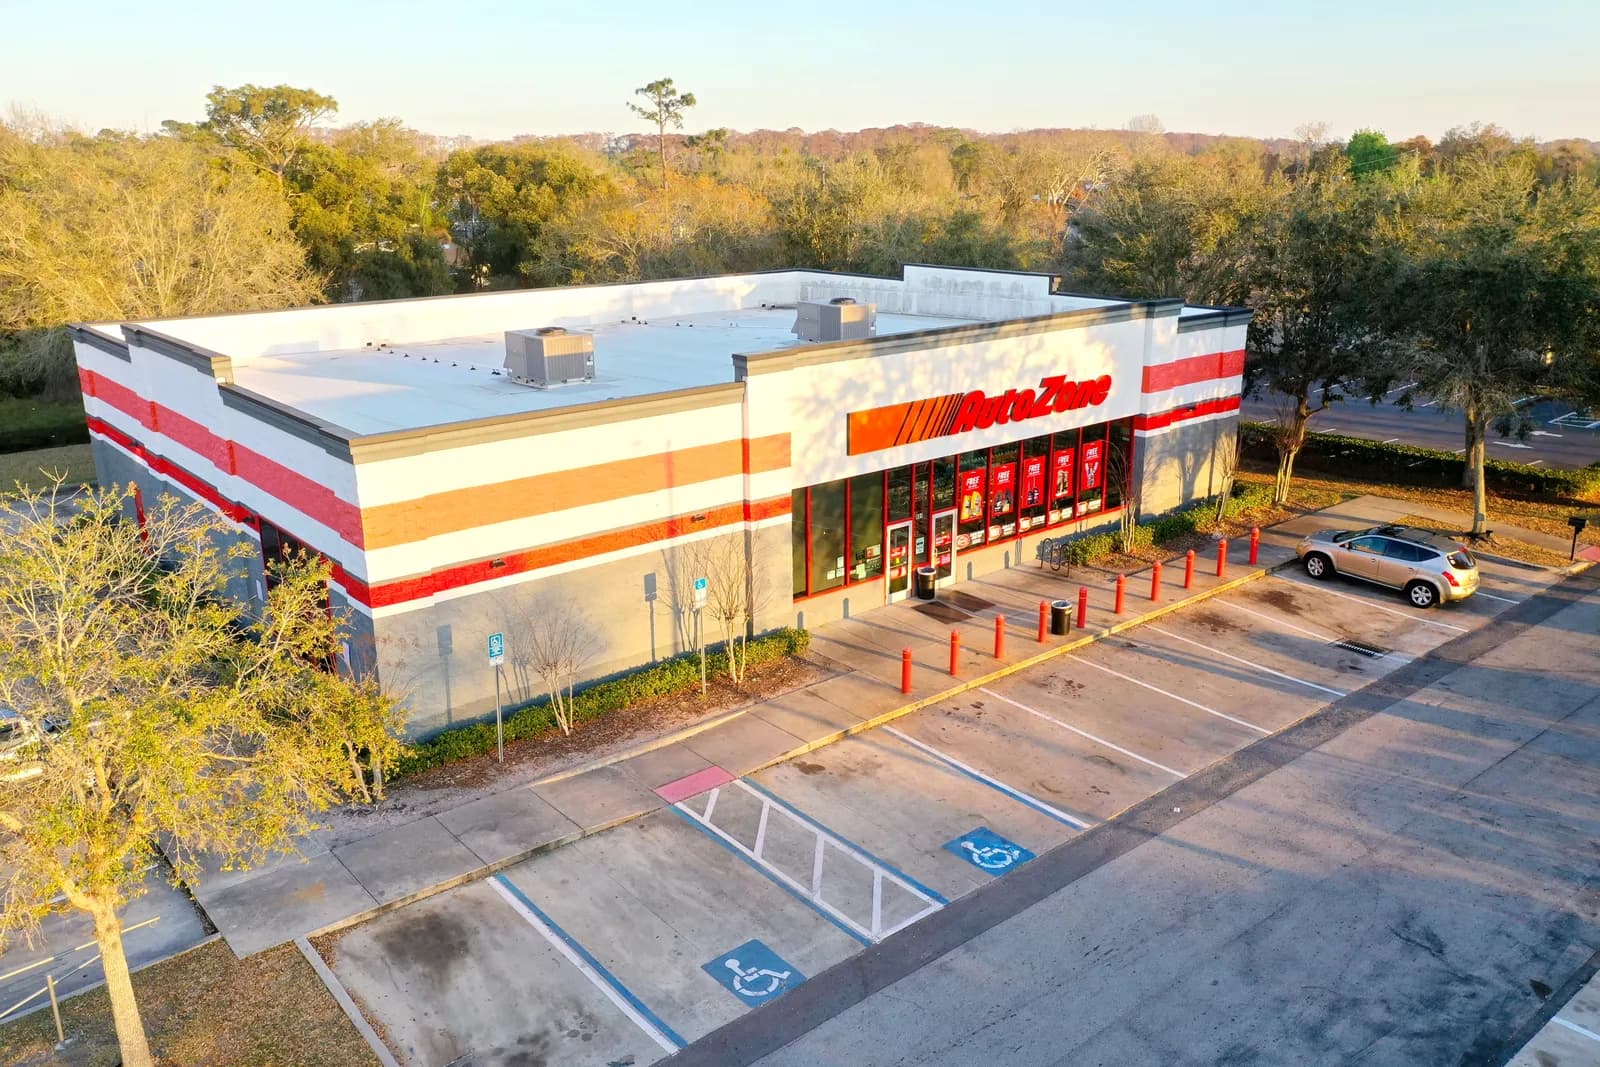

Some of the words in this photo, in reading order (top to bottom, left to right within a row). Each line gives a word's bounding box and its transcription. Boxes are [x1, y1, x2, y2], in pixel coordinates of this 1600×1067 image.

[951, 375, 1112, 435] AutoZone
[1087, 447, 1098, 456] FREE
[1058, 455, 1070, 464] FREE
[1028, 463, 1040, 473] FREE
[998, 470, 1010, 480] FREE
[966, 476, 980, 486] FREE
